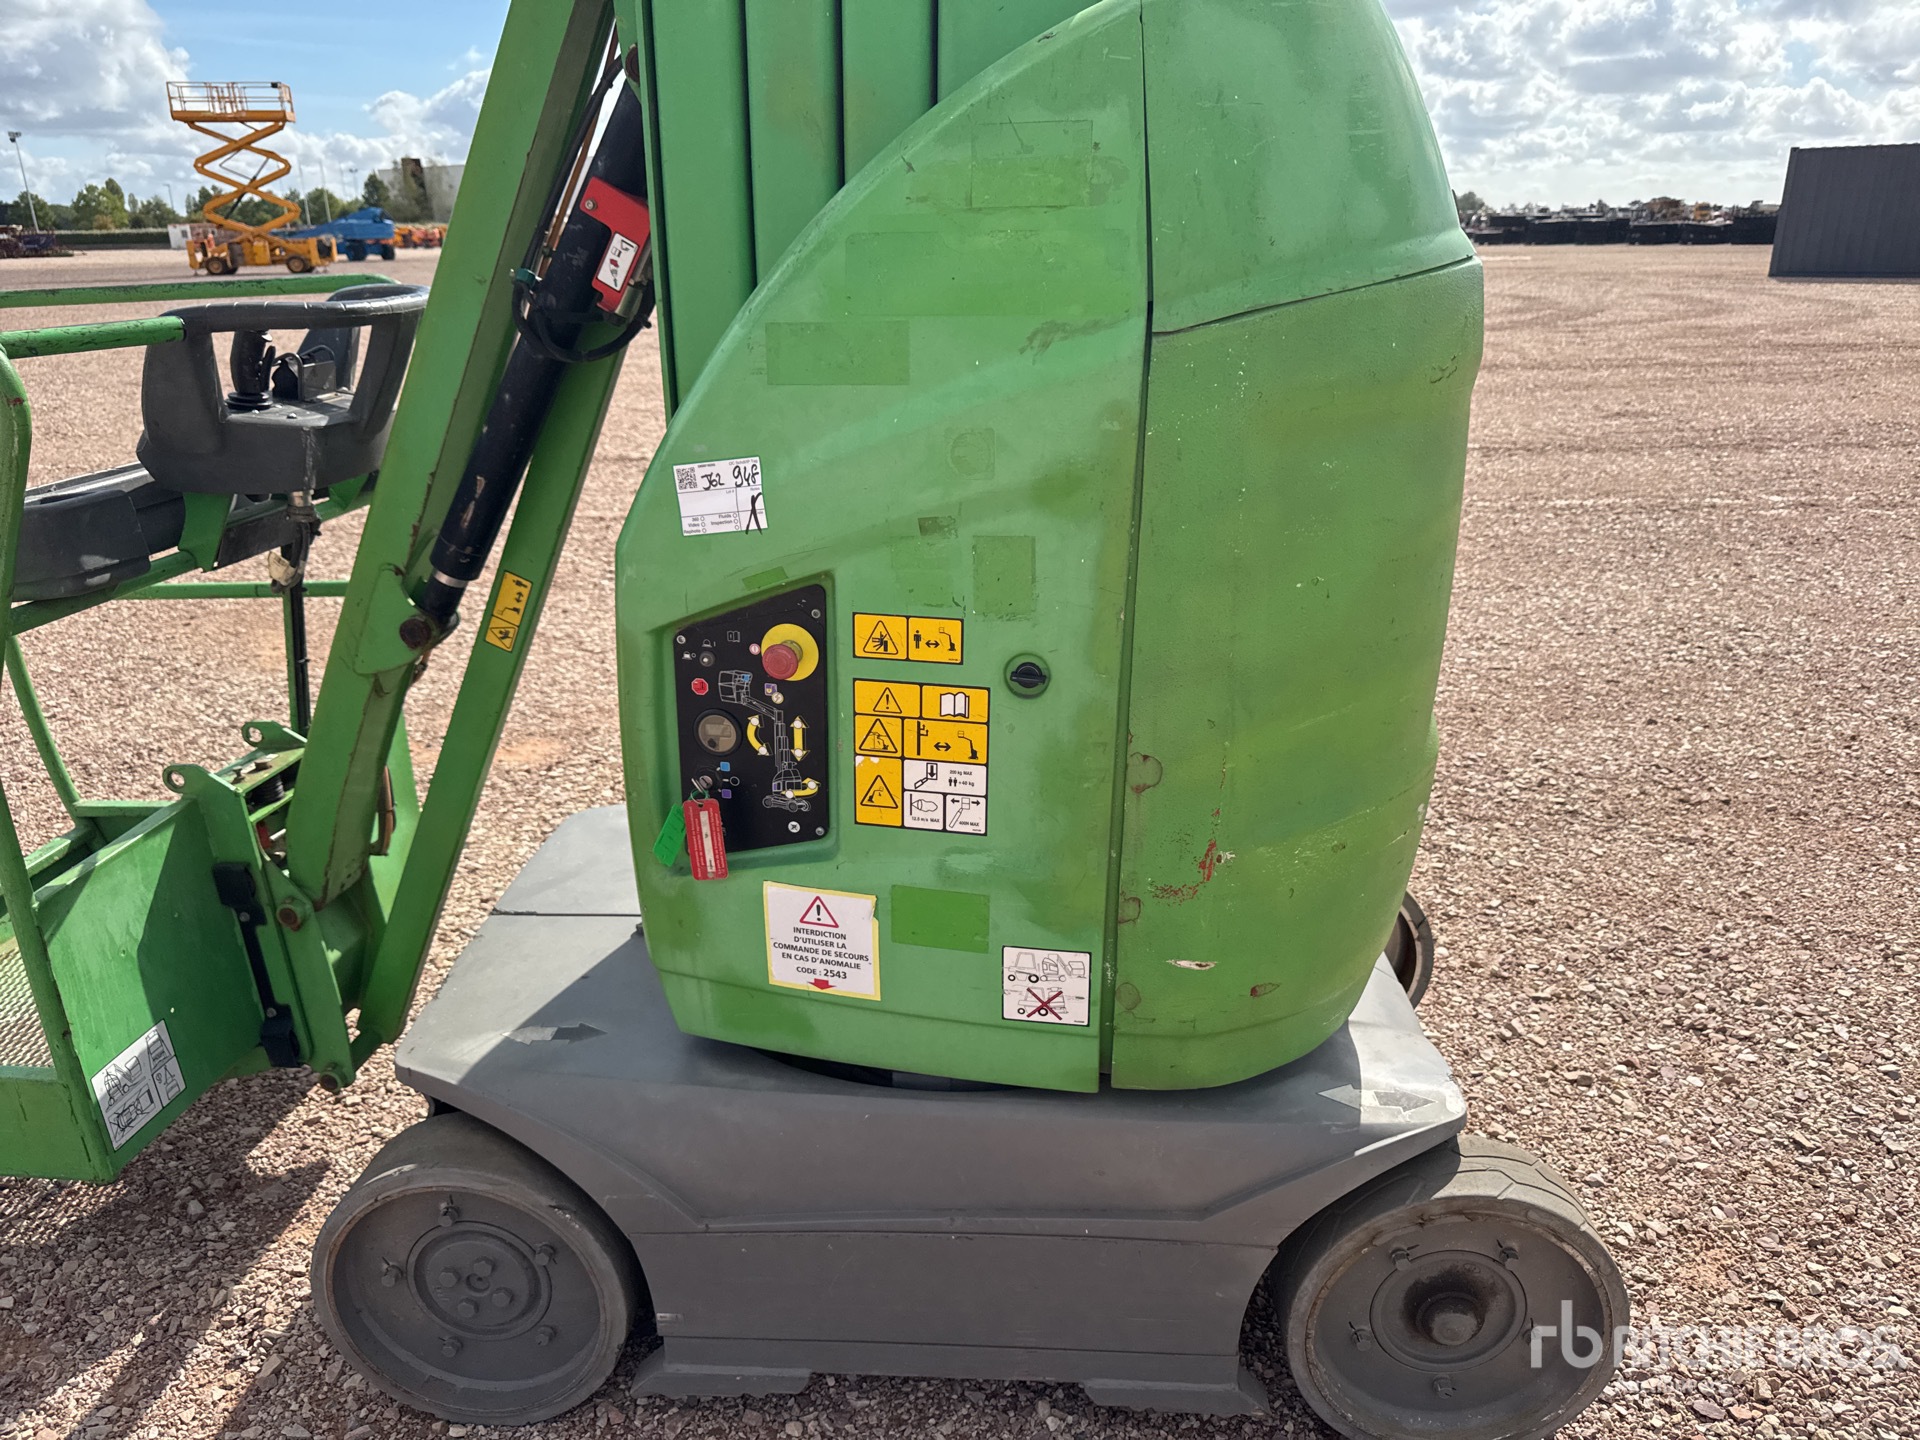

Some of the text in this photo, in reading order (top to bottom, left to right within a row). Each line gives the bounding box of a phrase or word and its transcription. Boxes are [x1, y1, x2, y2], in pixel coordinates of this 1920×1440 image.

[793, 927, 847, 940] INTERDICTION
[794, 936, 834, 948] D'UTILISER
[773, 942, 819, 954] COMMANDE
[834, 951, 869, 962] SECOURS
[796, 966, 817, 975] CODE
[823, 968, 847, 979] 2543
